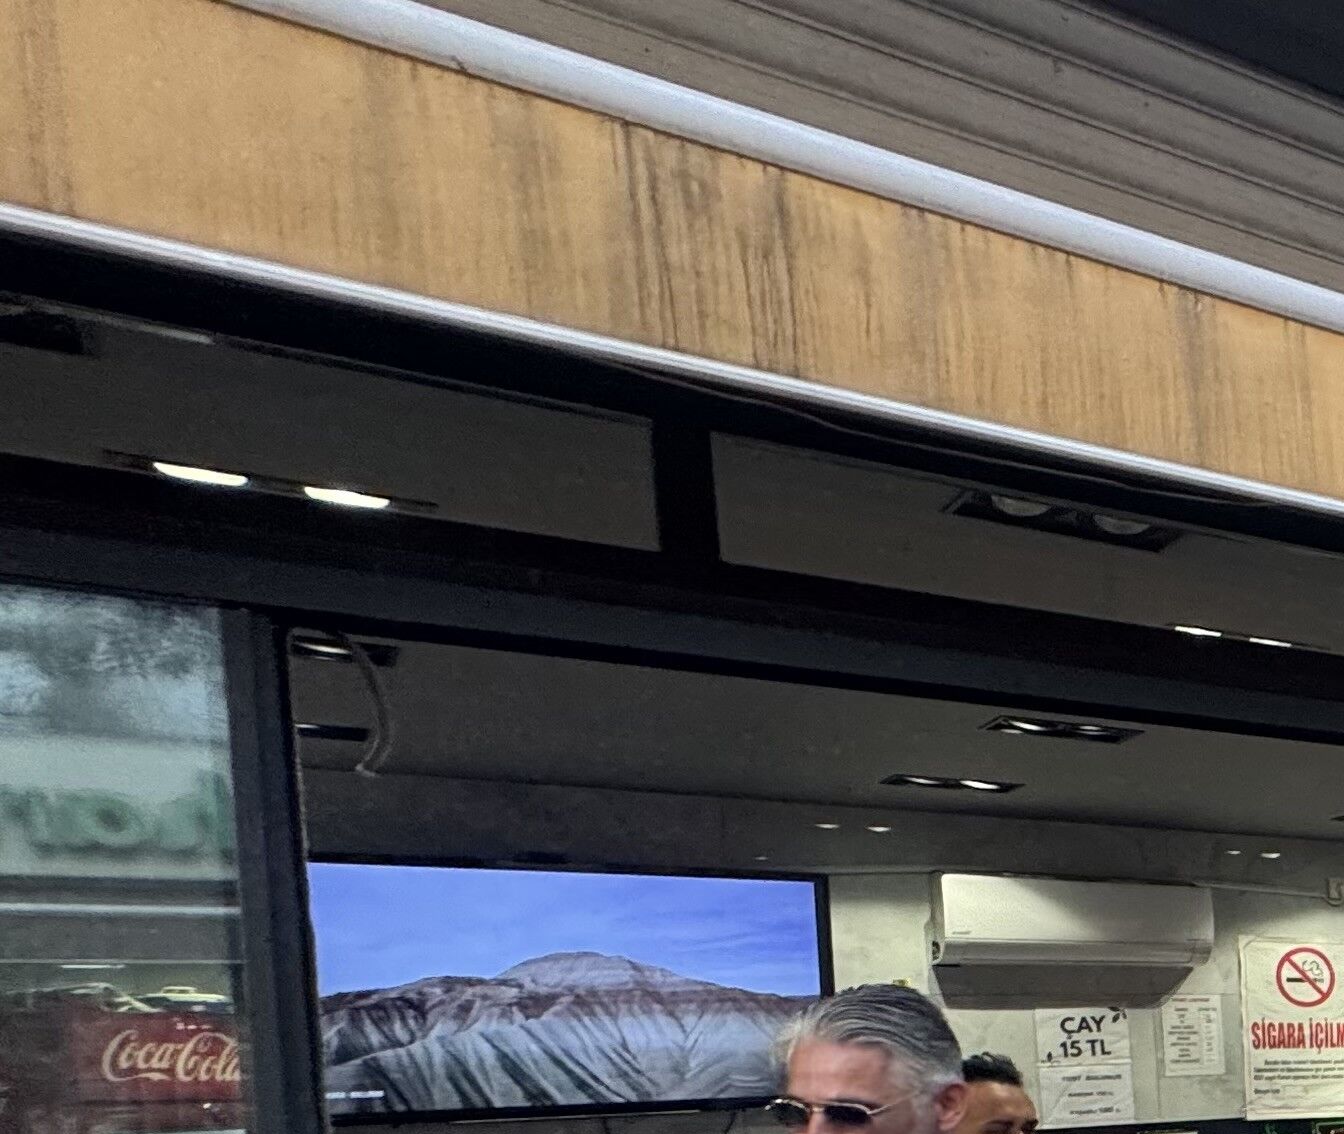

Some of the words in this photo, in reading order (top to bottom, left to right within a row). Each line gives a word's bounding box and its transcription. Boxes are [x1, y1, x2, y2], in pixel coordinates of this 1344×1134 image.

[1059, 1015, 1106, 1041] ÇAY
[1250, 1017, 1307, 1050] SİGARA
[1059, 1040, 1083, 1059] 15
[1086, 1039, 1112, 1057] TL
